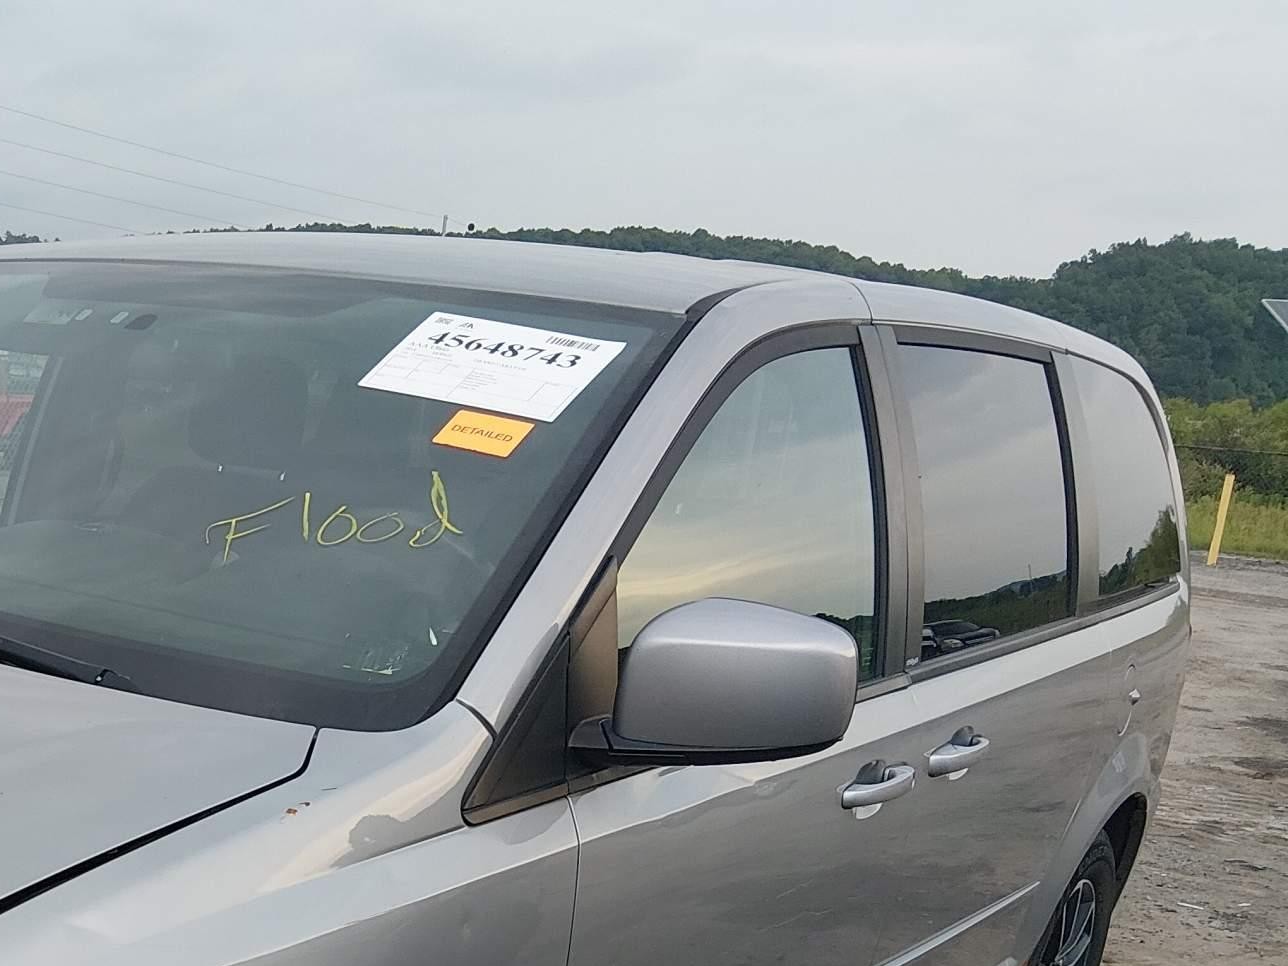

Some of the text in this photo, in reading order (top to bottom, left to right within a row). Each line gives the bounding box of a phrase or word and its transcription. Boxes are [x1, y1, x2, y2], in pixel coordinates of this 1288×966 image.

[427, 331, 581, 369] 45648743
[450, 423, 513, 443] DETAILED
[205, 470, 463, 565] Flood
